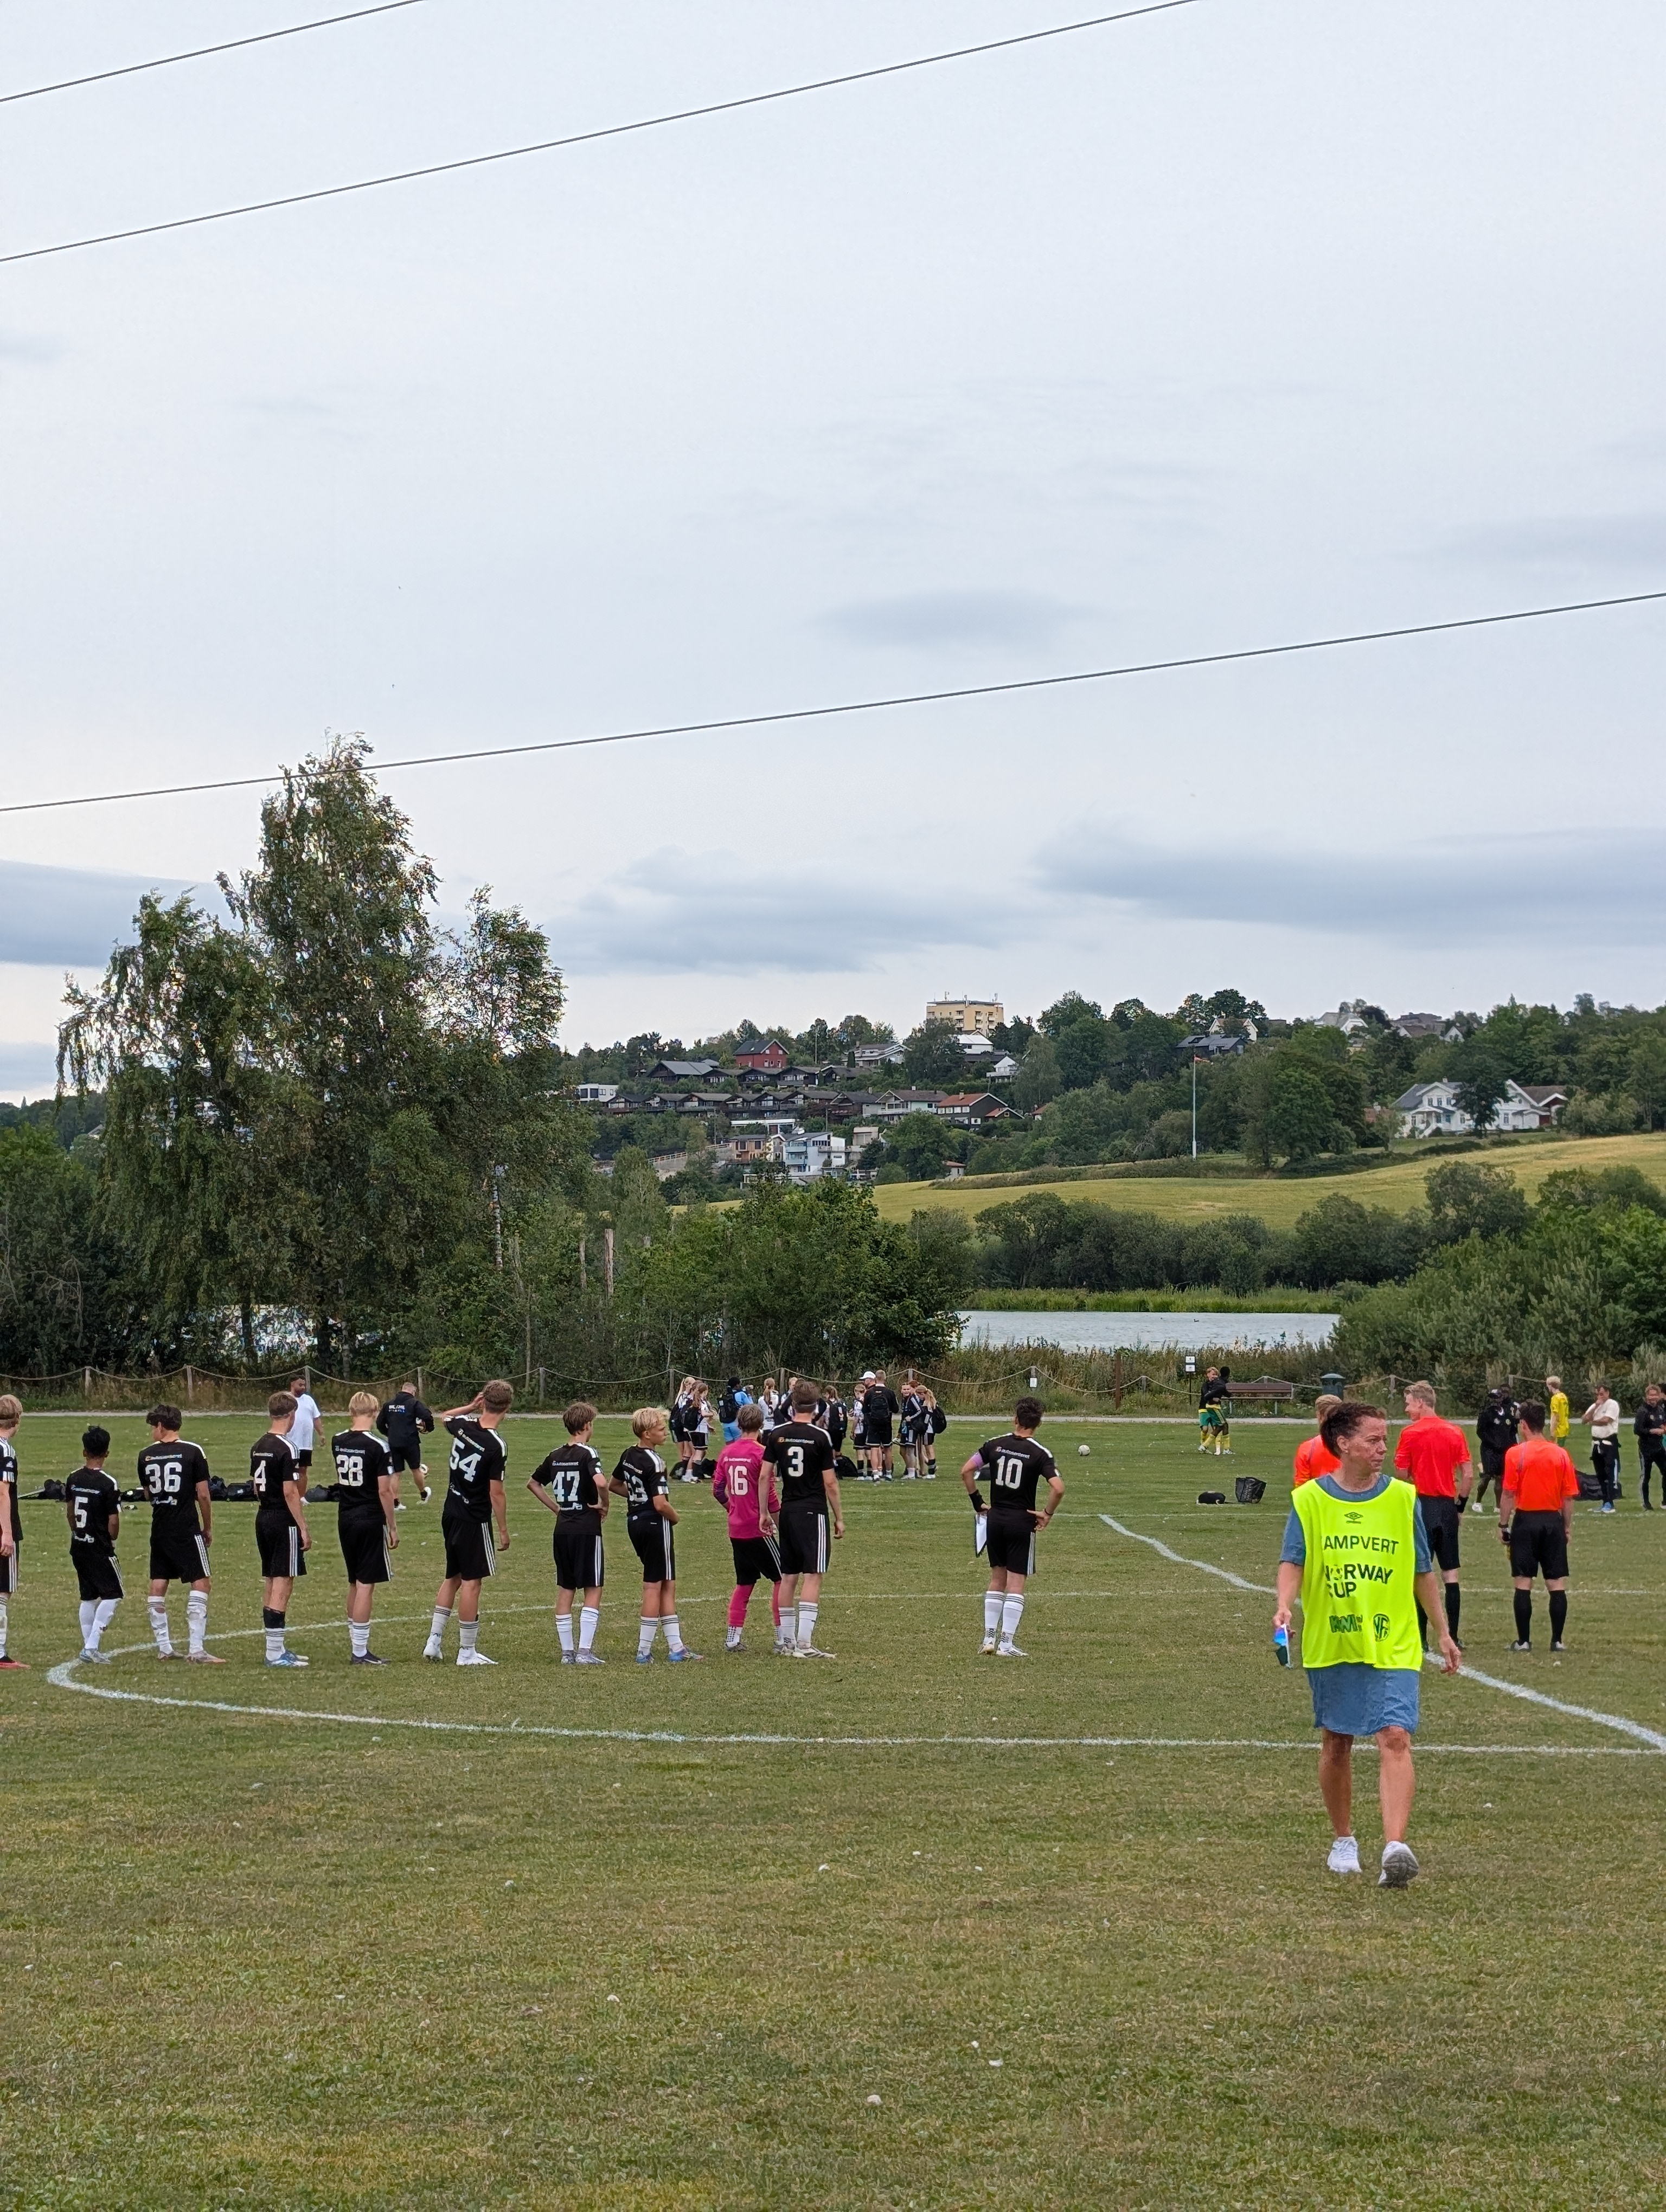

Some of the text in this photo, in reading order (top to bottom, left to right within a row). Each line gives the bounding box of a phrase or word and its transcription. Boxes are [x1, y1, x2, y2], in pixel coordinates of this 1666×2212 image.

[450, 1437, 482, 1482] 54
[787, 1446, 804, 1477] 3
[1001, 1449, 1030, 1459] autosenteret
[145, 1462, 182, 1494] 36
[254, 1460, 266, 1492] 4
[336, 1455, 363, 1487] 28
[553, 1471, 580, 1502] 47
[728, 1465, 748, 1495] 16
[996, 1456, 1023, 1489] 10
[74, 1496, 88, 1528] 5
[1324, 1535, 1399, 1555] AMPVERT
